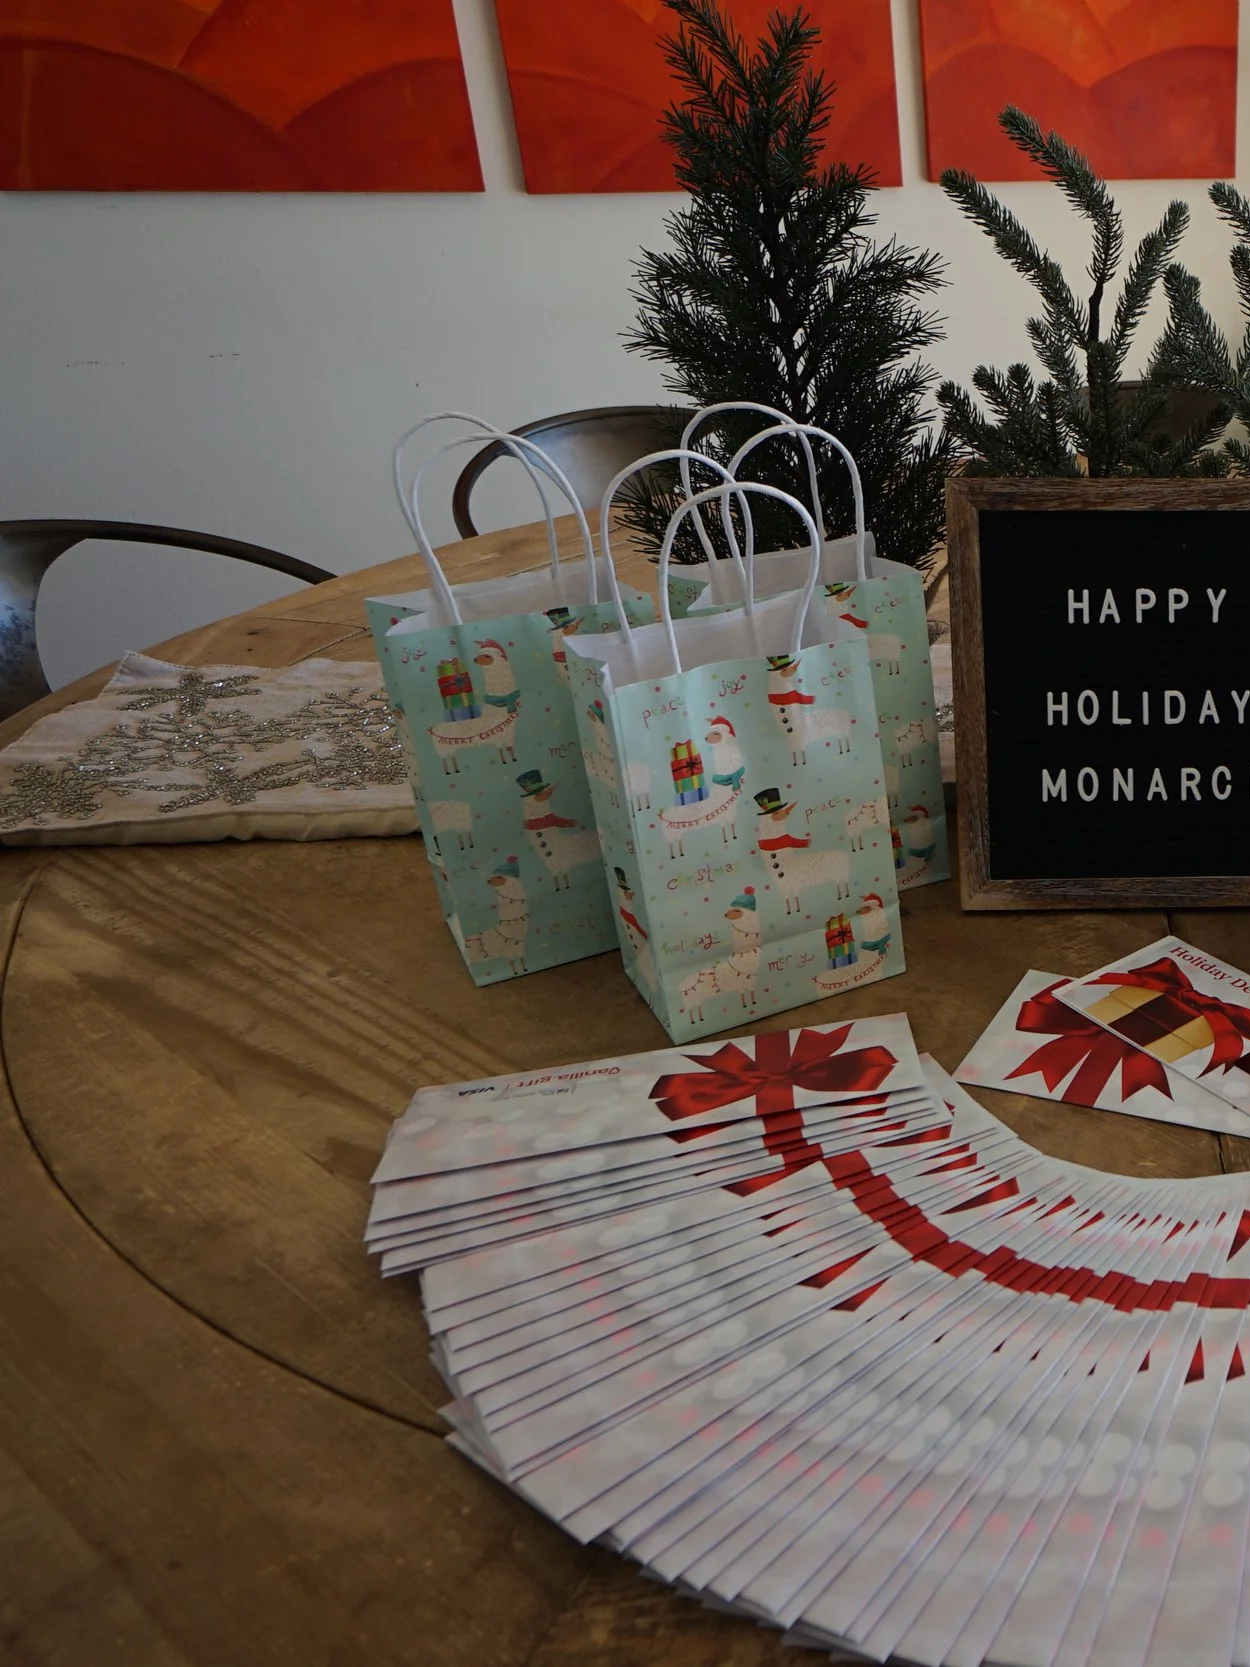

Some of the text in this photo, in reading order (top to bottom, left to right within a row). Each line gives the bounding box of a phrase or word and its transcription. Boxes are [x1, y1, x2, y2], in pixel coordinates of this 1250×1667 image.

[1067, 587, 1227, 624] HAPPY
[718, 677, 745, 698] joy
[666, 789, 744, 831] MERRY CHRISTMAS
[1170, 946, 1233, 981] Holiday
[516, 1074, 552, 1089] gift
[557, 1065, 621, 1081] Vanilla
[457, 1085, 497, 1098] VISA
